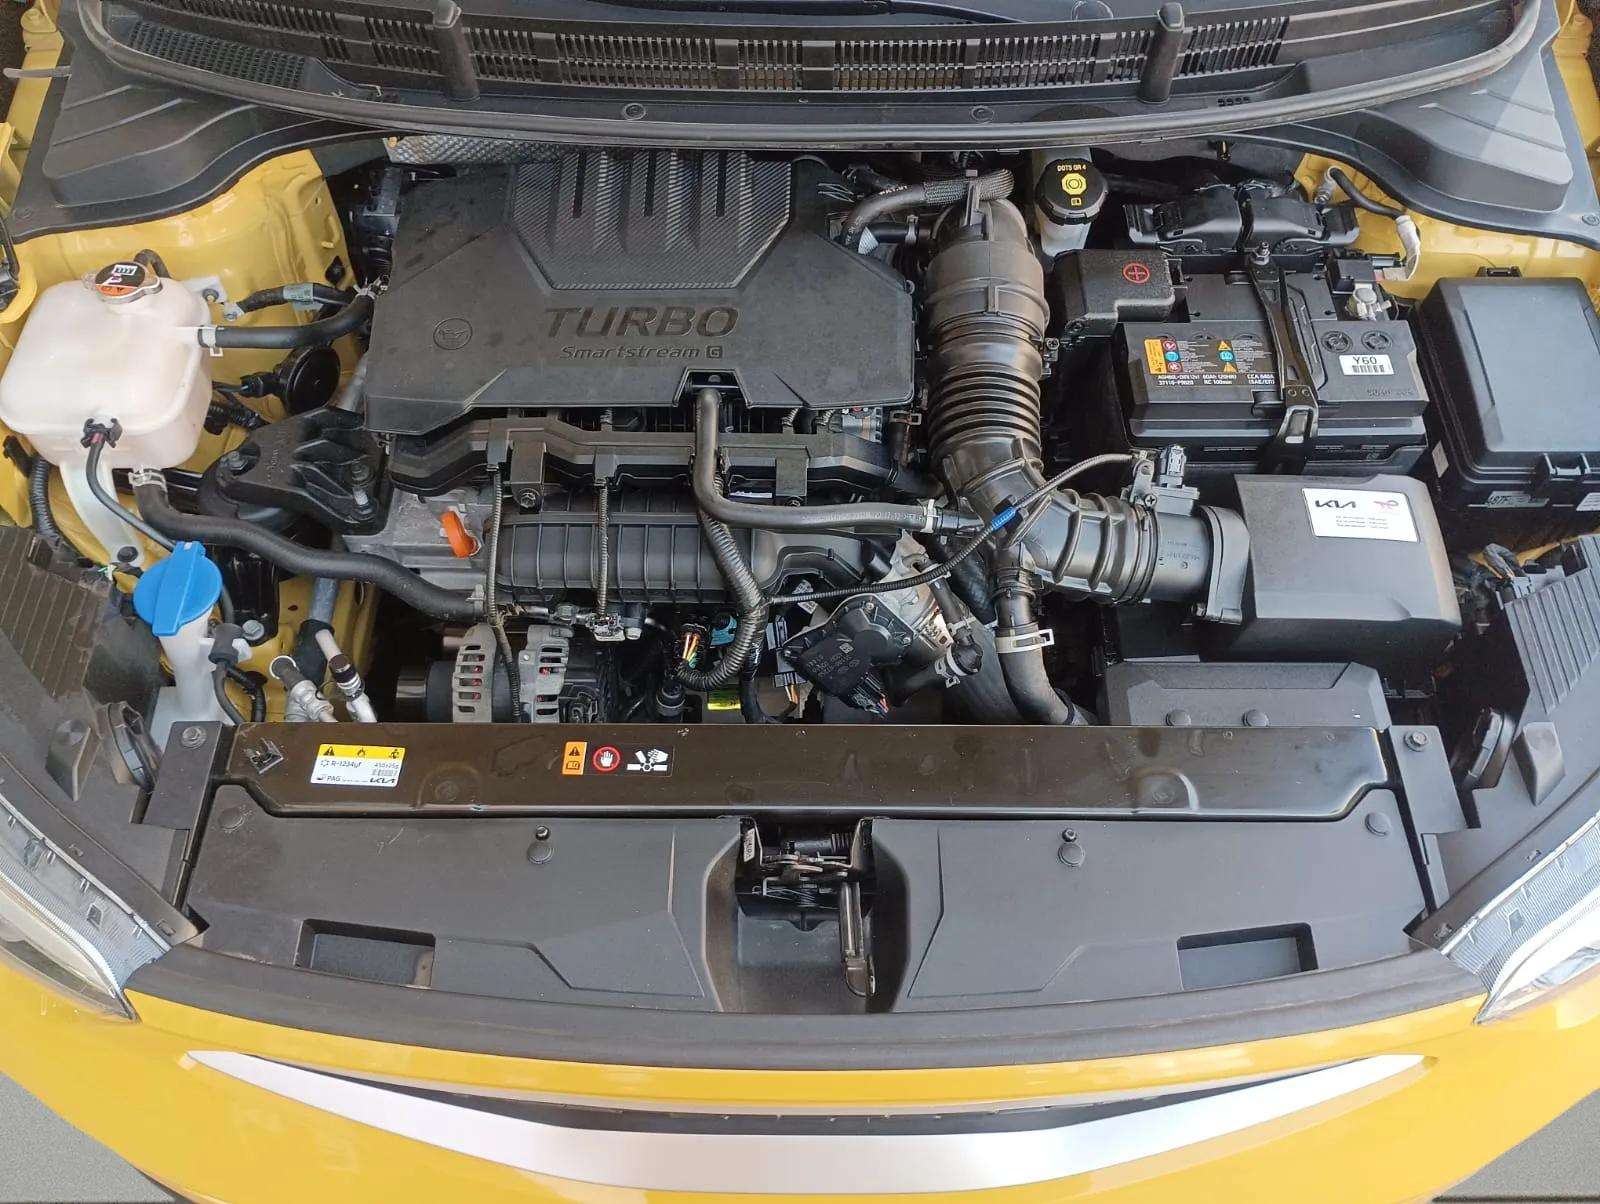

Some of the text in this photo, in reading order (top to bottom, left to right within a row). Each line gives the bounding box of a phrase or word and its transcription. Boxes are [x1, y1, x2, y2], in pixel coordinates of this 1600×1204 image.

[545, 305, 739, 338] TURBO
[559, 345, 700, 360] Smartstream
[1353, 355, 1377, 365] Y60
[1315, 499, 1356, 509] KIA
